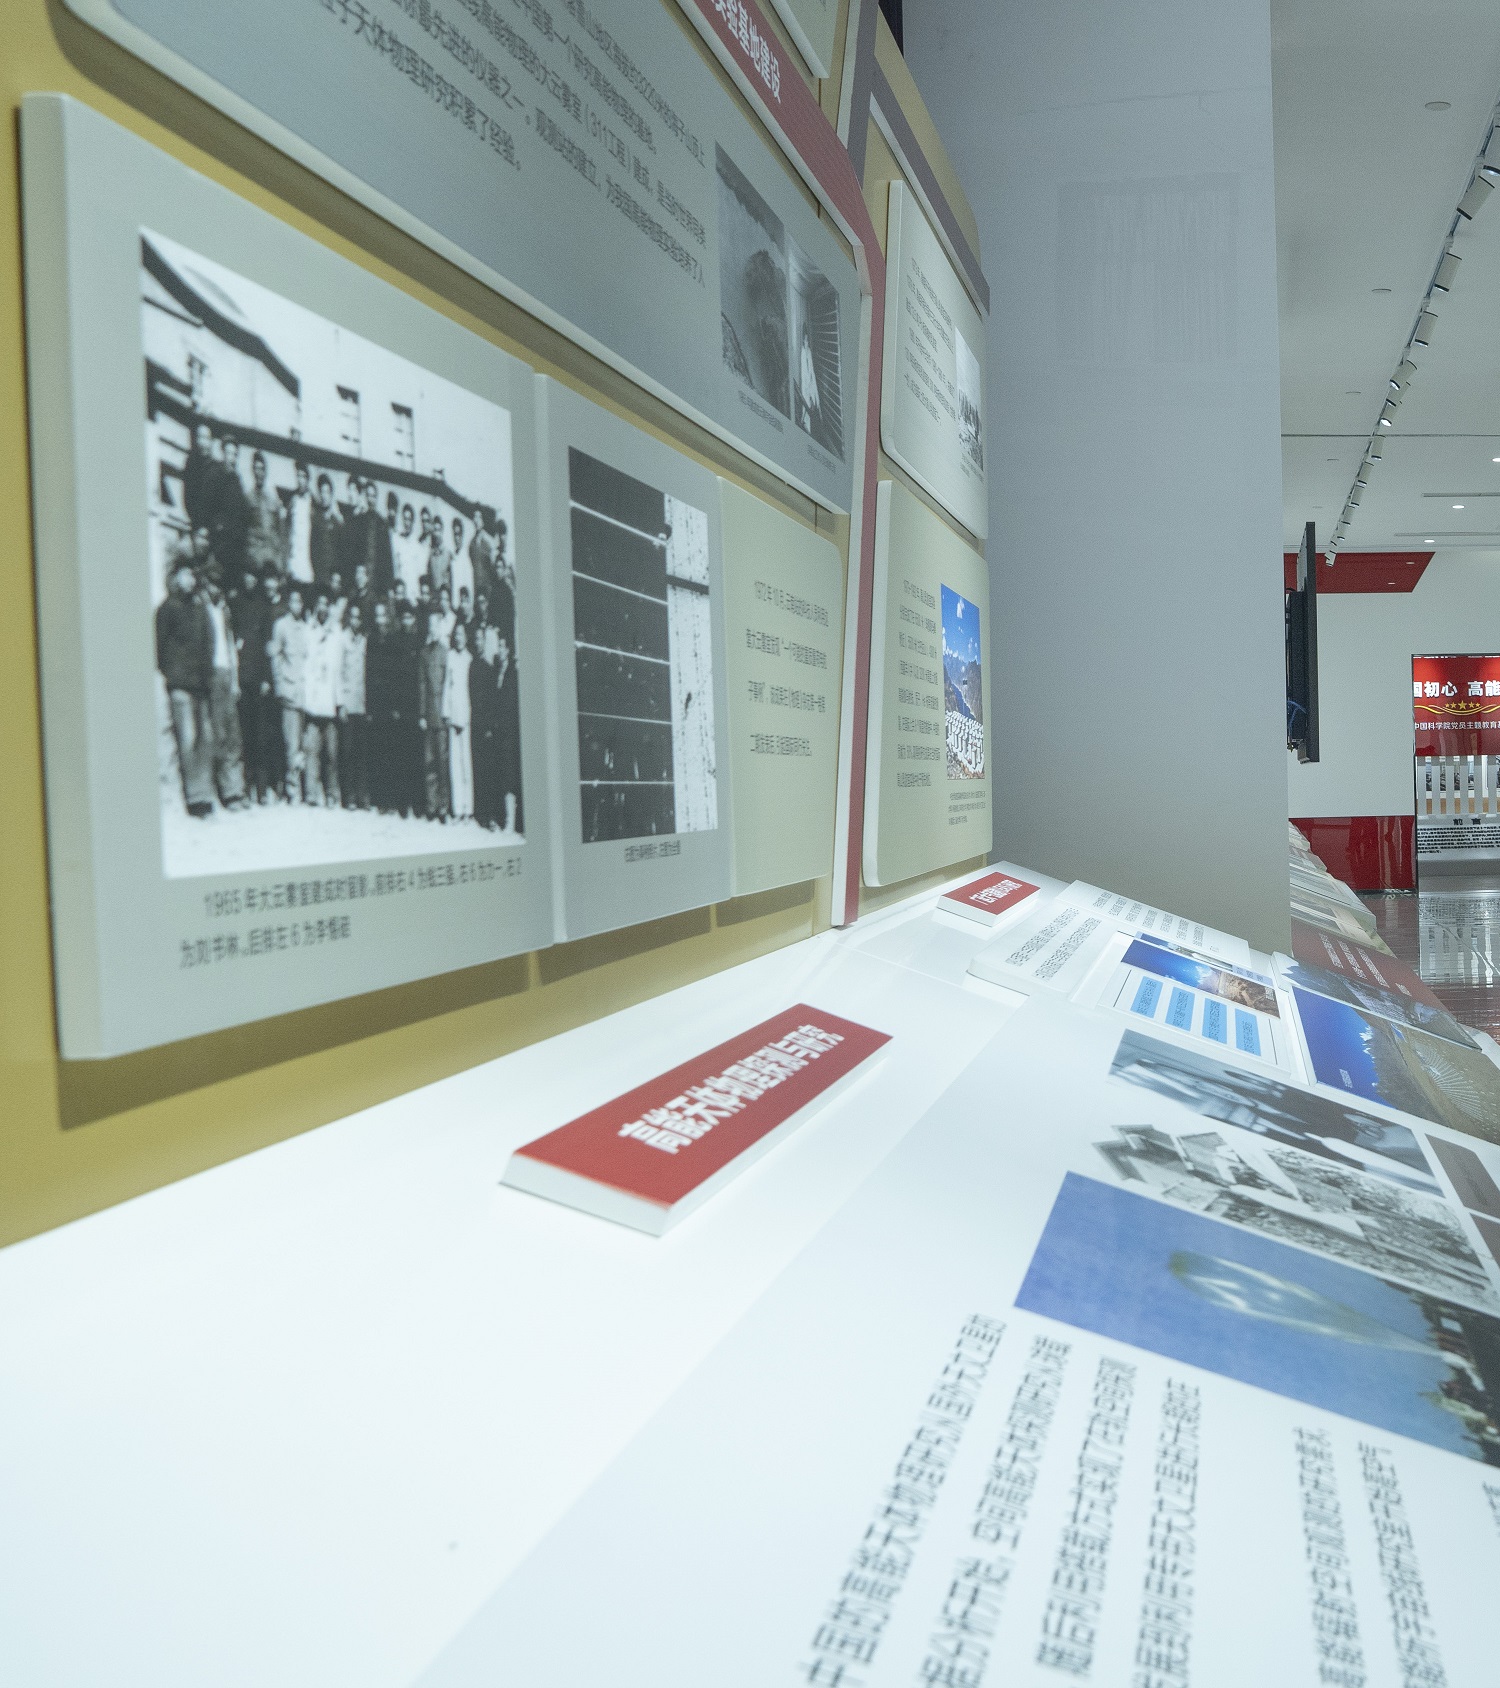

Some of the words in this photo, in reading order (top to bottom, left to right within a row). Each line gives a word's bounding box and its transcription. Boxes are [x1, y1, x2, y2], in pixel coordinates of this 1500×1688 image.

[617, 1024, 845, 1155] 高能天体物理探测与研究
